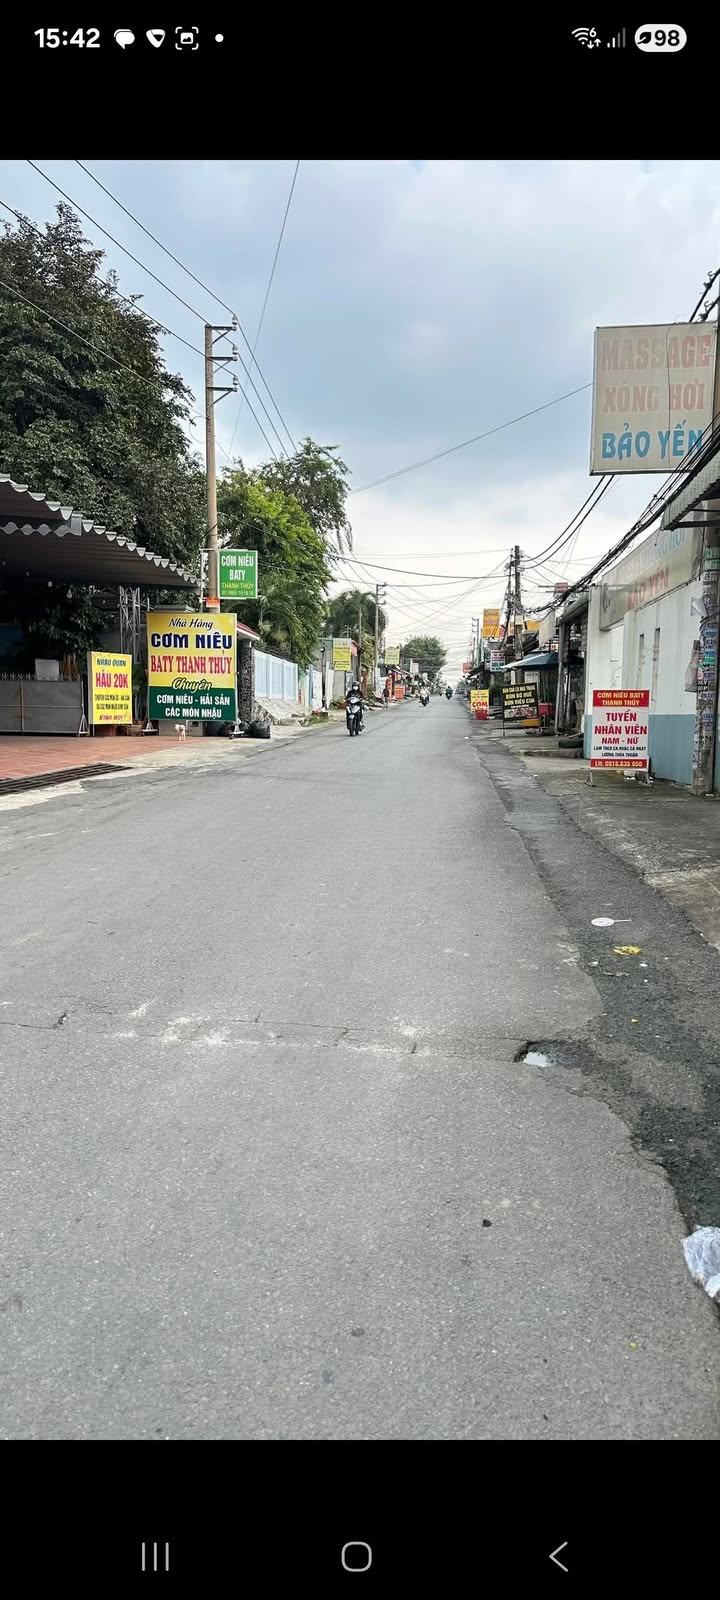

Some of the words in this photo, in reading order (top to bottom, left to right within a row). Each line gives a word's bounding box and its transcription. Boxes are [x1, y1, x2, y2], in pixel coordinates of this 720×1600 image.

[602, 335, 712, 371] MASSAGE
[602, 423, 650, 461] BẢO
[658, 420, 704, 460] YẾN
[229, 570, 245, 580] BATY
[169, 618, 187, 627] Nhà
[189, 618, 214, 630] Hàng
[151, 632, 189, 649] CƠM
[195, 631, 232, 649] NIÊU
[151, 655, 174, 673] BATY
[176, 656, 206, 674] THANH
[114, 673, 128, 688] 20K
[172, 677, 212, 693] Chuyên
[157, 694, 174, 704] CƠM
[176, 693, 193, 704] NIÊU
[200, 693, 213, 705] HẢI
[214, 693, 230, 706] SẢN
[165, 706, 180, 717] CÁC
[182, 707, 199, 717] MÓN
[201, 707, 222, 720] NHẬU
[606, 709, 637, 722] TUYỂN
[594, 724, 622, 735] NHÂN
[625, 724, 647, 735] VIÊN
